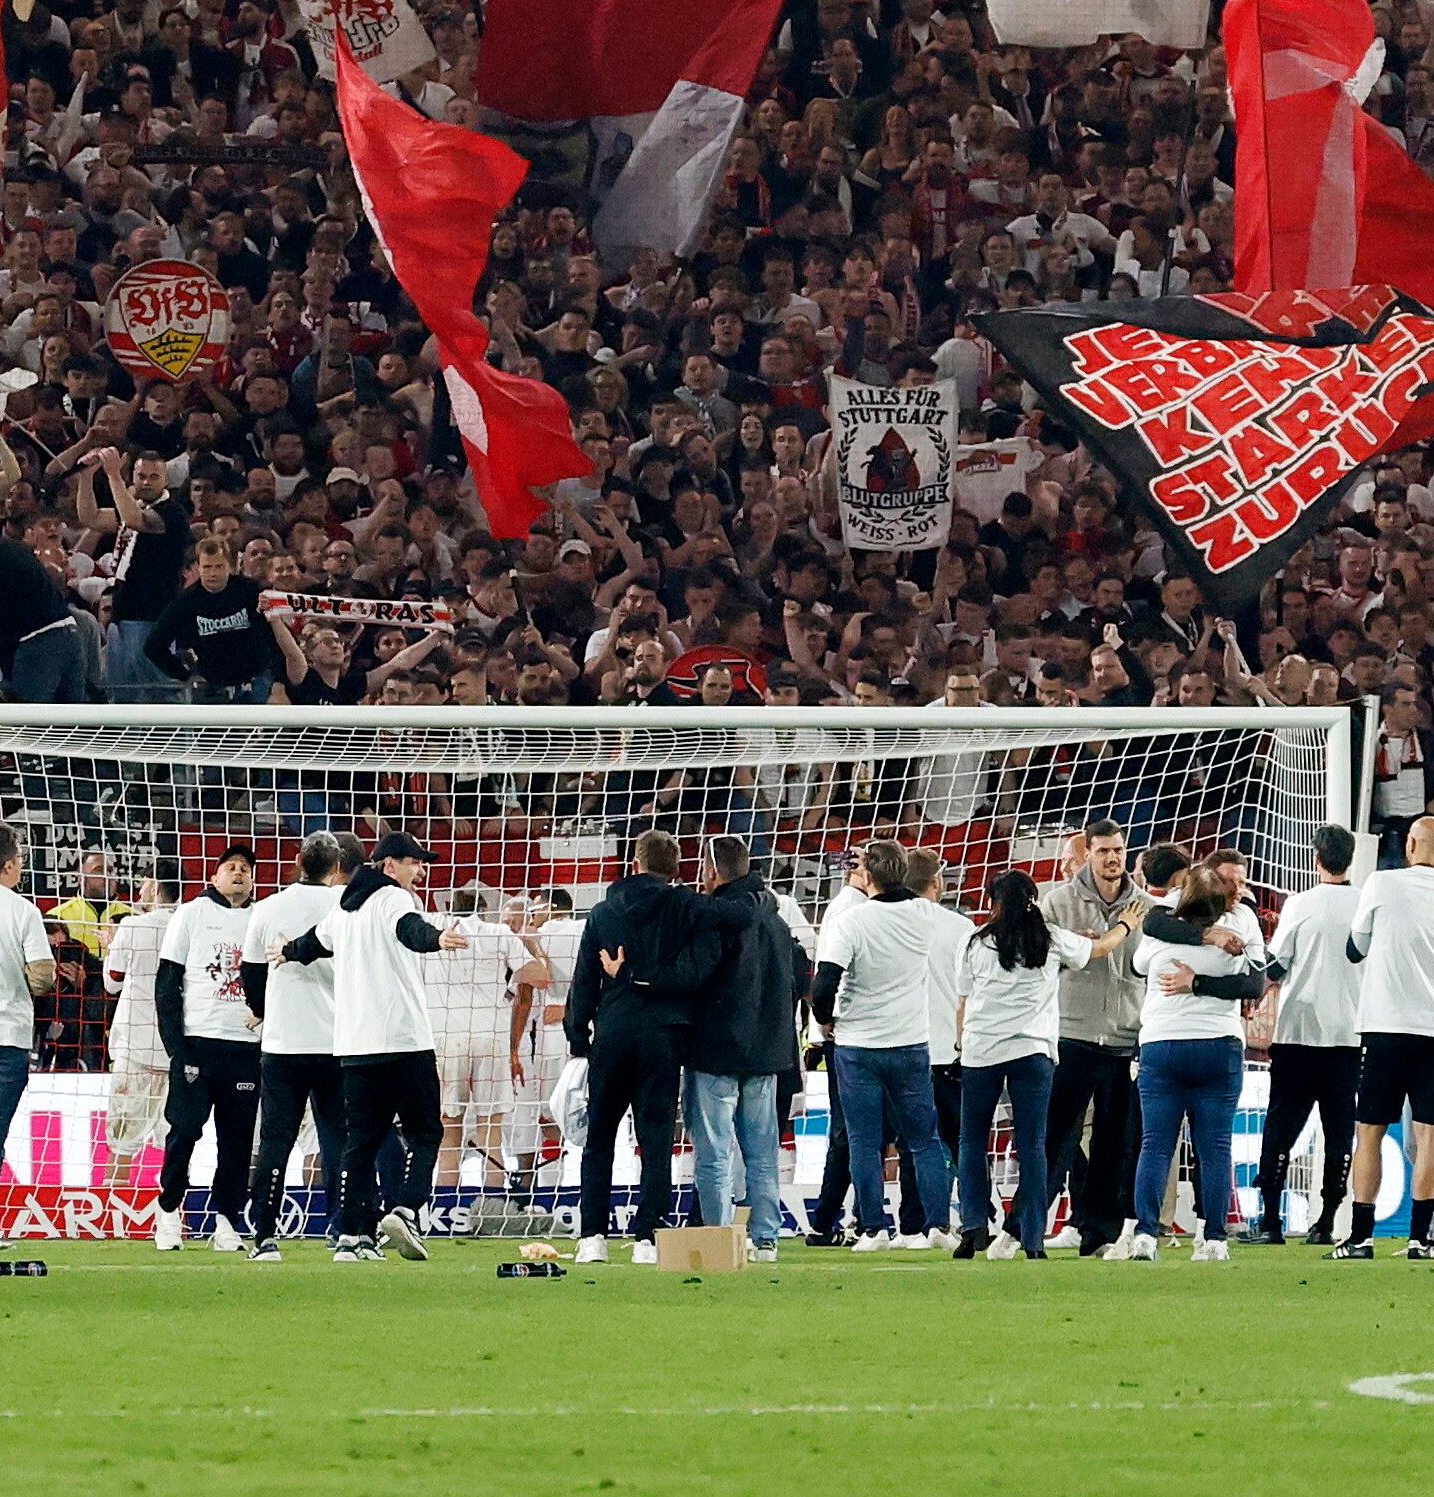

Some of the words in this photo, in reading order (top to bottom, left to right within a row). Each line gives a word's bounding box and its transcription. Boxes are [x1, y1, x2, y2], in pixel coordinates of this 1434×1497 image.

[847, 388, 900, 406] ALLES
[906, 387, 941, 407] FÜR
[838, 406, 948, 428] STUTTGART
[842, 484, 946, 507] BLUTGRUPPE
[848, 512, 895, 540] WEISS
[907, 513, 940, 538] ROT
